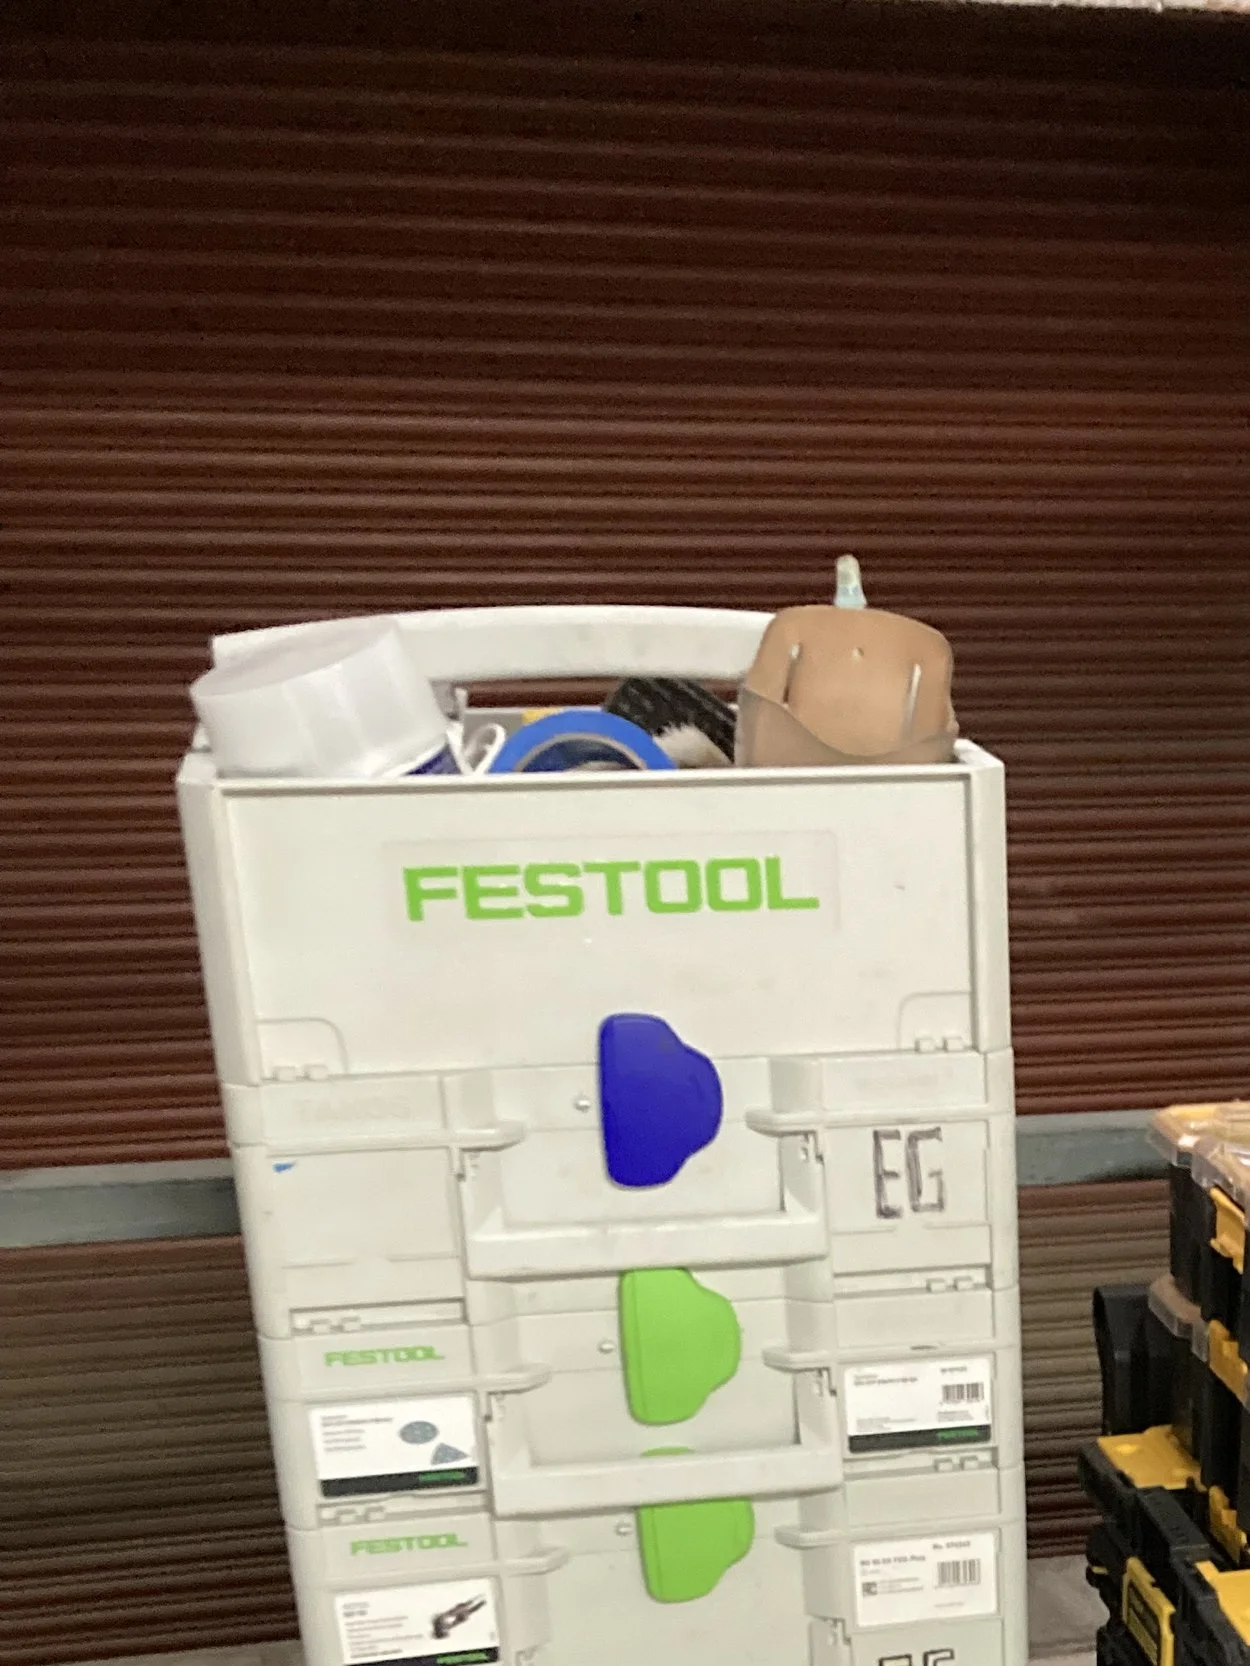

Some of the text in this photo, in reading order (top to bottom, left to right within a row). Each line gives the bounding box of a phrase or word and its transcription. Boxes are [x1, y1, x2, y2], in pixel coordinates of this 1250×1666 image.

[403, 857, 819, 921] FESTOOL
[873, 1126, 945, 1219] EG
[324, 1346, 445, 1367] FESTOOL
[350, 1533, 468, 1556] FESTOOL
